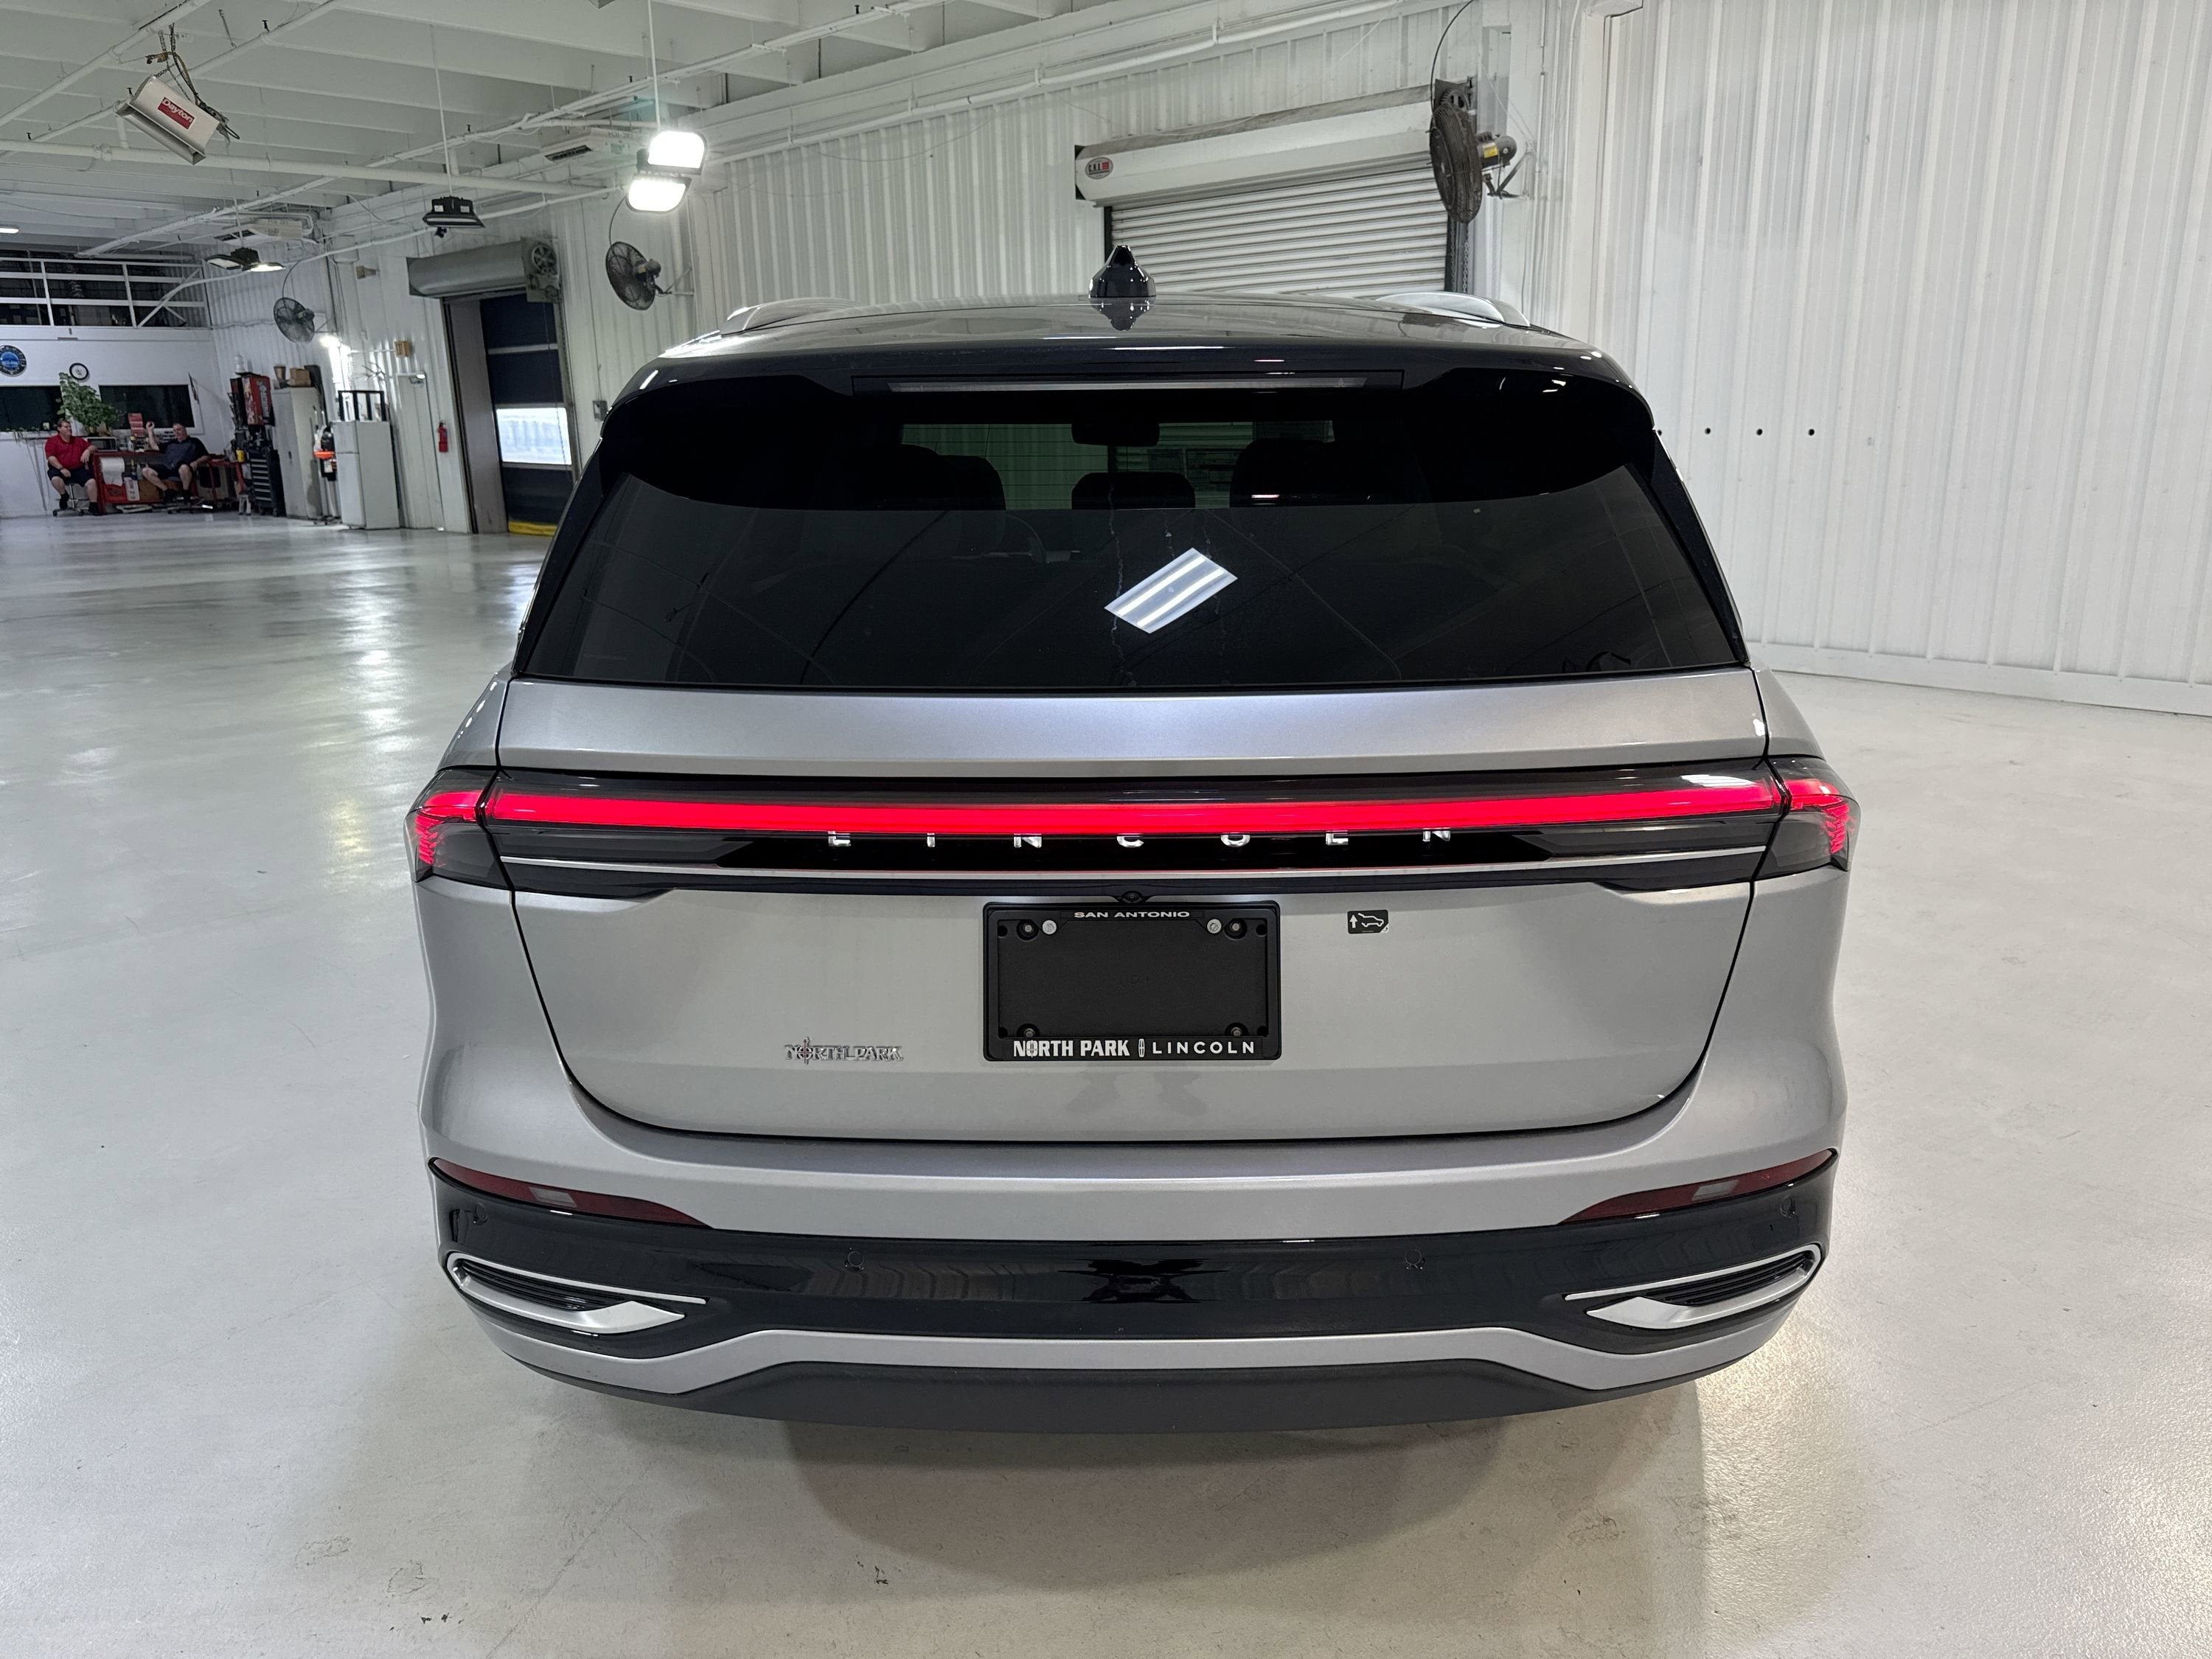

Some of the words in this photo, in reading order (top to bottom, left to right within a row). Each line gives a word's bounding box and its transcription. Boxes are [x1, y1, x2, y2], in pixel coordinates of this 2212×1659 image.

[161, 98, 193, 122] Dayton
[1074, 911, 1108, 919] SAN
[785, 1040, 850, 1062] NORTH
[854, 1045, 904, 1062] PARK
[1013, 1040, 1074, 1057] NORTH
[1080, 1040, 1130, 1057] PARK
[1152, 1040, 1255, 1054] LINCOLN
